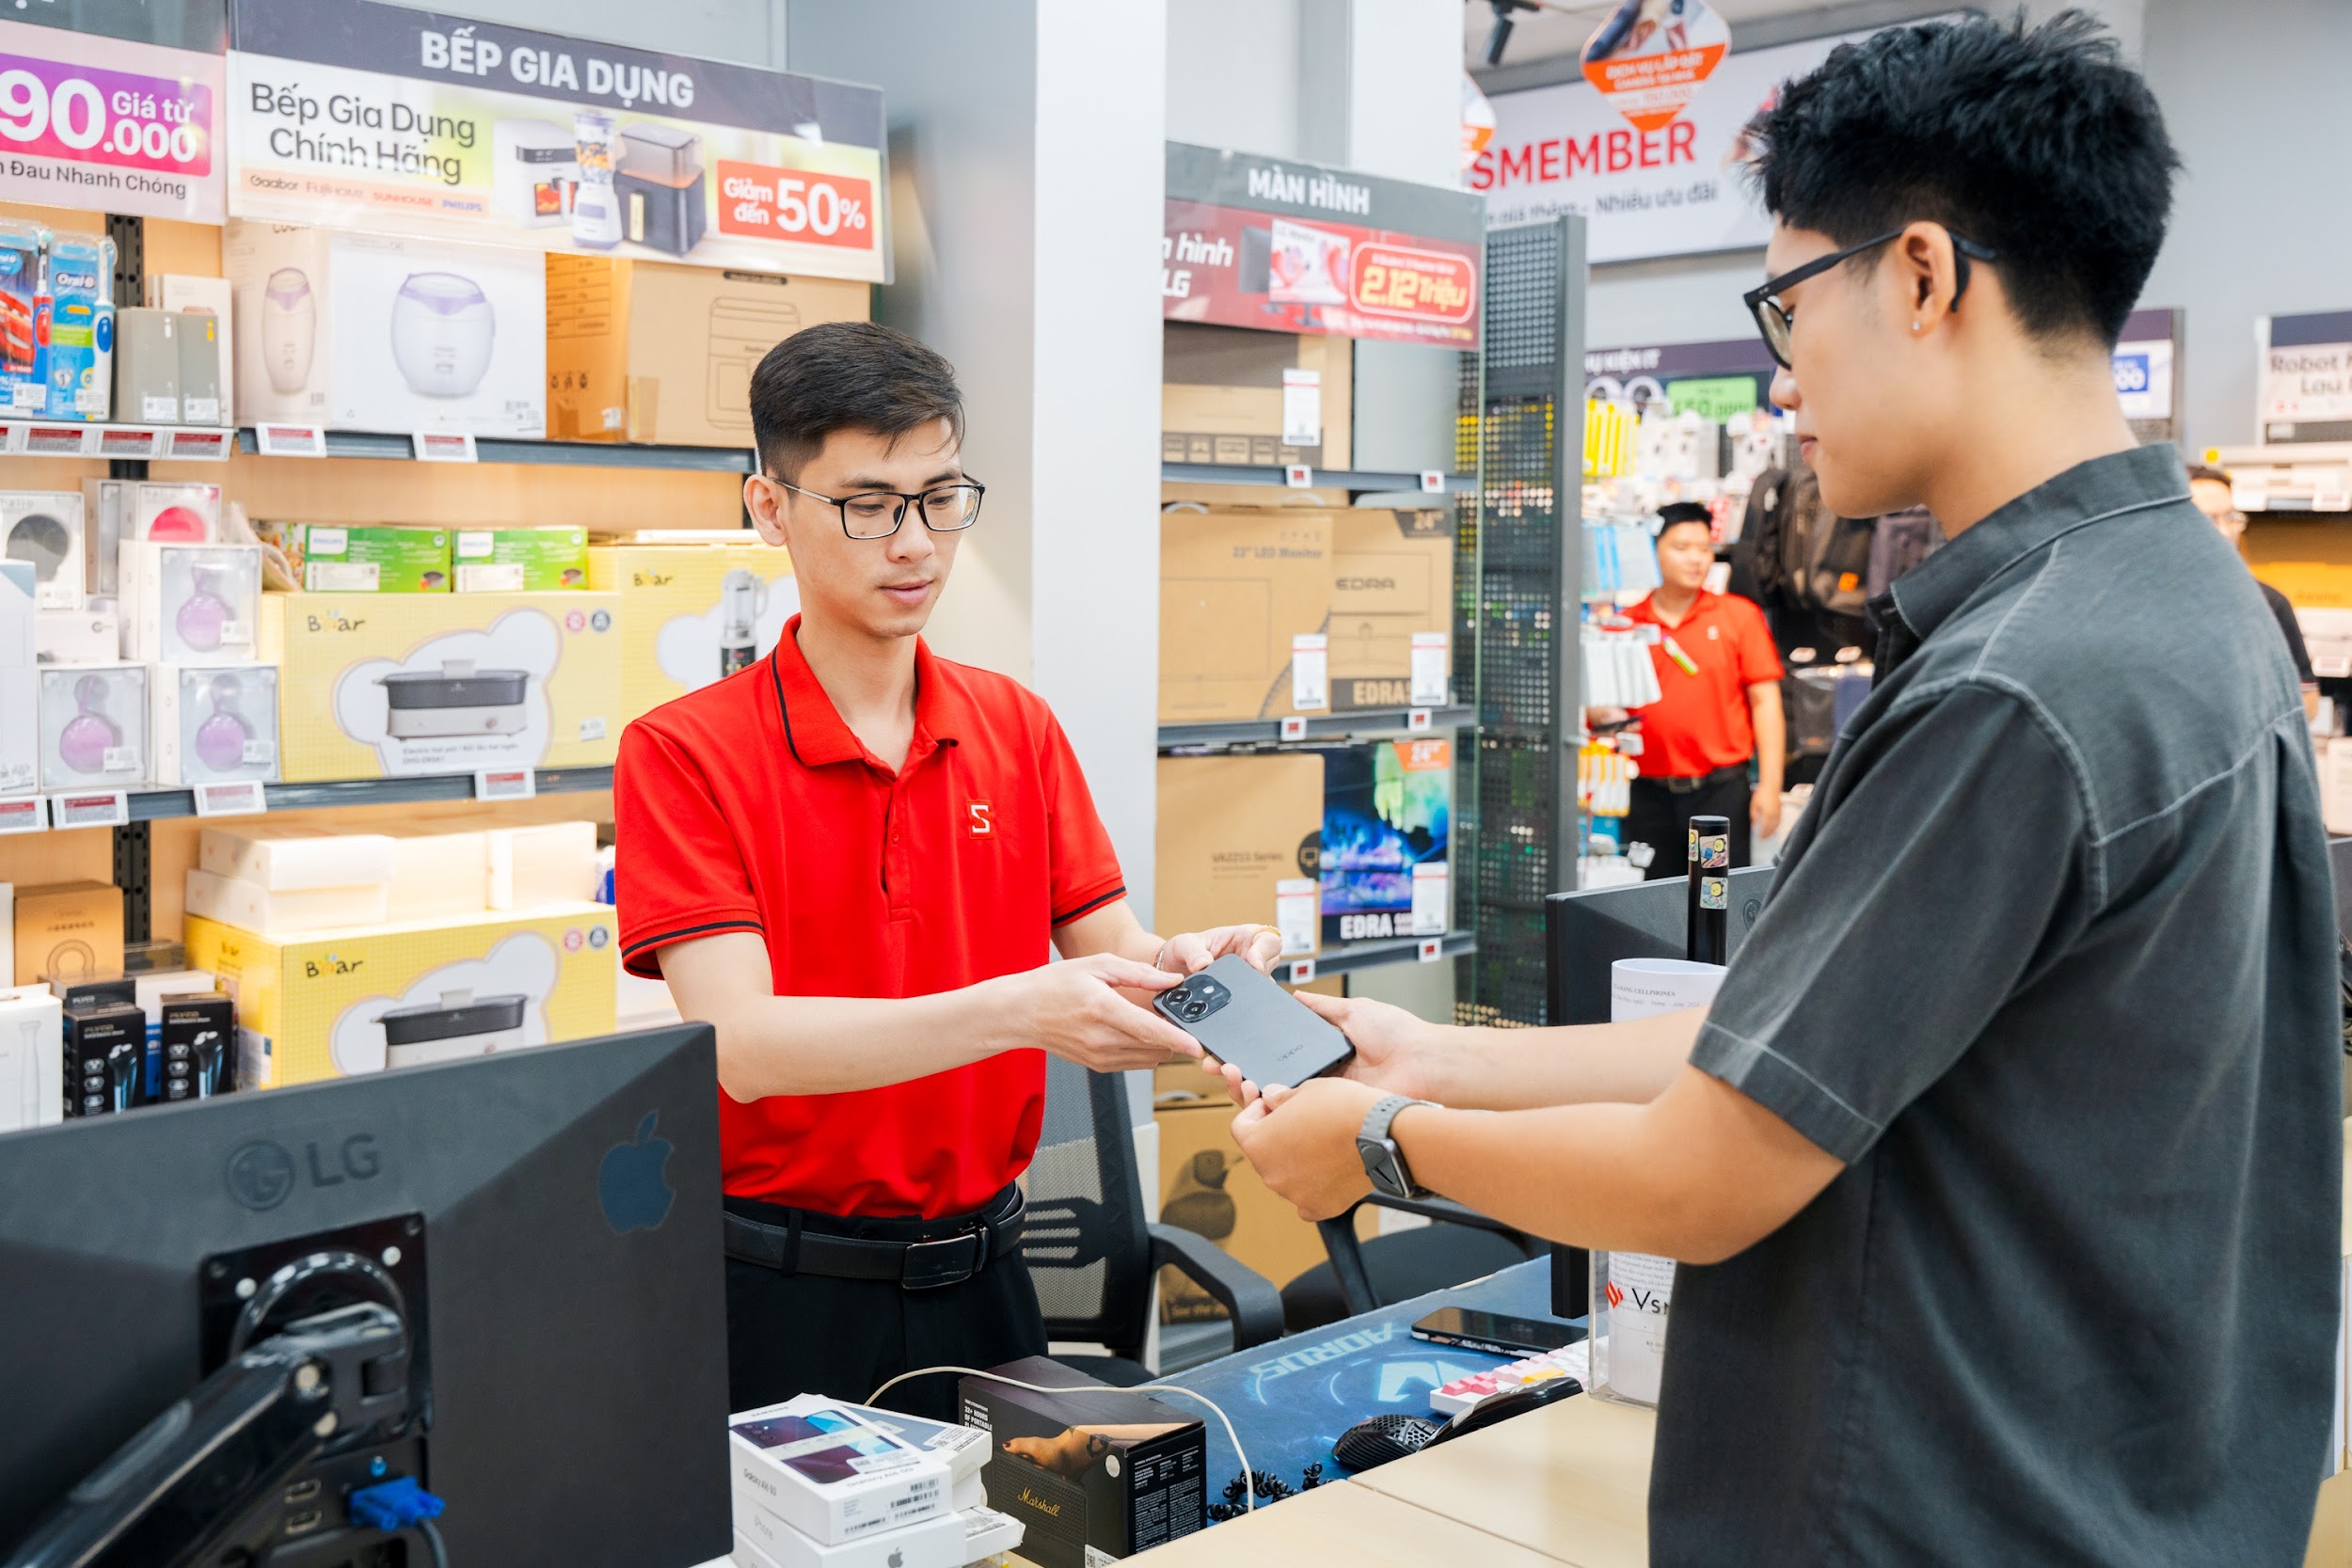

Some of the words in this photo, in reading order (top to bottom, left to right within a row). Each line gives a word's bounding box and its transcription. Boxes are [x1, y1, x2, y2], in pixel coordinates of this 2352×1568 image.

[421, 26, 502, 76] BẾP
[510, 47, 580, 91] GIA
[586, 58, 694, 108] DỤNG
[112, 90, 156, 119] Giá
[162, 97, 196, 123] từ
[250, 83, 320, 126] Bếp
[328, 94, 383, 129] Gia
[390, 103, 476, 149] Dụng
[269, 127, 368, 168] Chính
[375, 141, 462, 187] Hãng
[1470, 119, 1699, 192] SMEMBER
[11, 160, 50, 180] Đau
[56, 166, 120, 188] Nhanh
[125, 173, 186, 200] Chóng
[1248, 165, 1305, 205] MÀN
[1309, 172, 1370, 215] HÌNH
[723, 176, 773, 203] Giảm
[775, 177, 866, 236] 50%
[733, 201, 770, 226] đến
[1175, 231, 1234, 268] hình
[1359, 265, 1420, 309] 2.12
[2270, 354, 2338, 373] Robot
[1340, 912, 1393, 940] EDRA
[306, 1132, 380, 1188] LG
[1248, 1322, 1392, 1382] AORUS
[1017, 1486, 1060, 1517] Marshall
